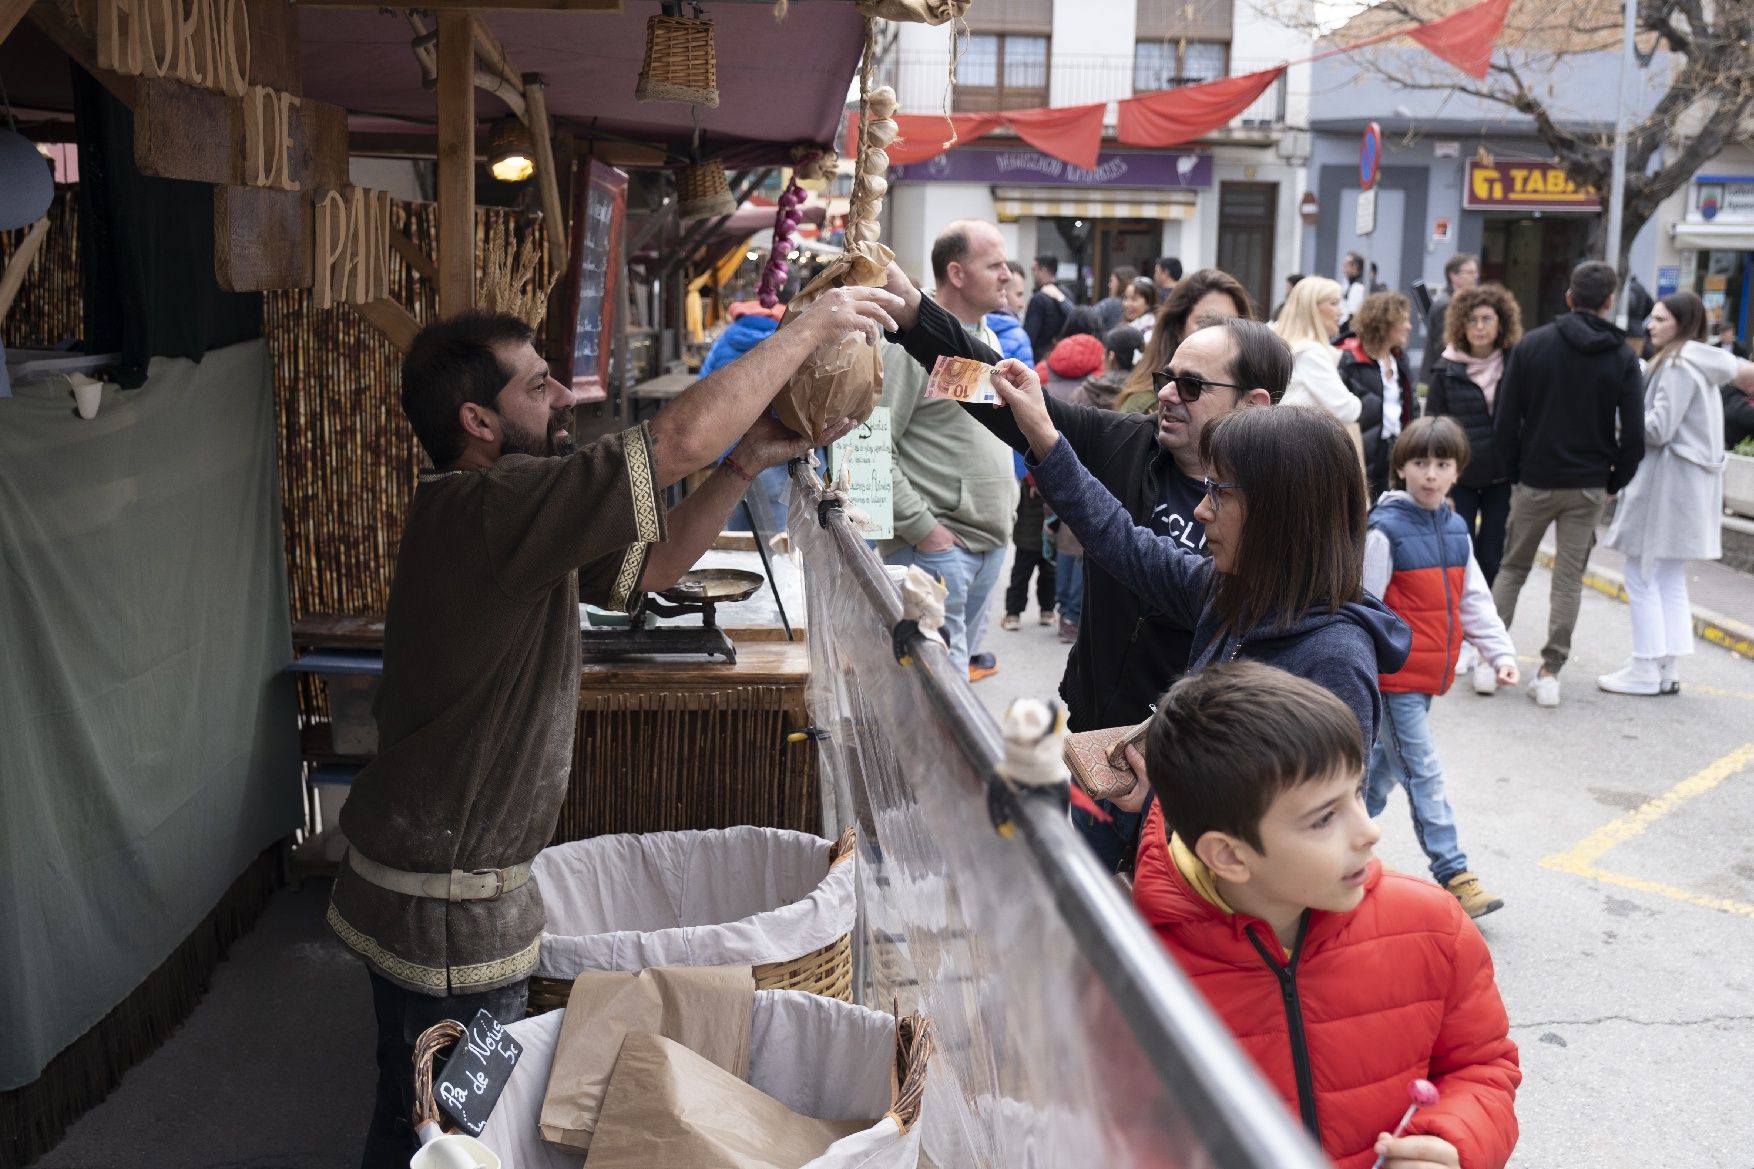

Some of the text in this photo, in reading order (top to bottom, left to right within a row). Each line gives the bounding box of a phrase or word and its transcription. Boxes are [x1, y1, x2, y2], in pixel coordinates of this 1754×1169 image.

[106, 0, 251, 97] HORNO
[252, 84, 301, 191] DE
[315, 186, 391, 309] PAN
[440, 1081, 468, 1110] Pa
[466, 1070, 489, 1095] de
